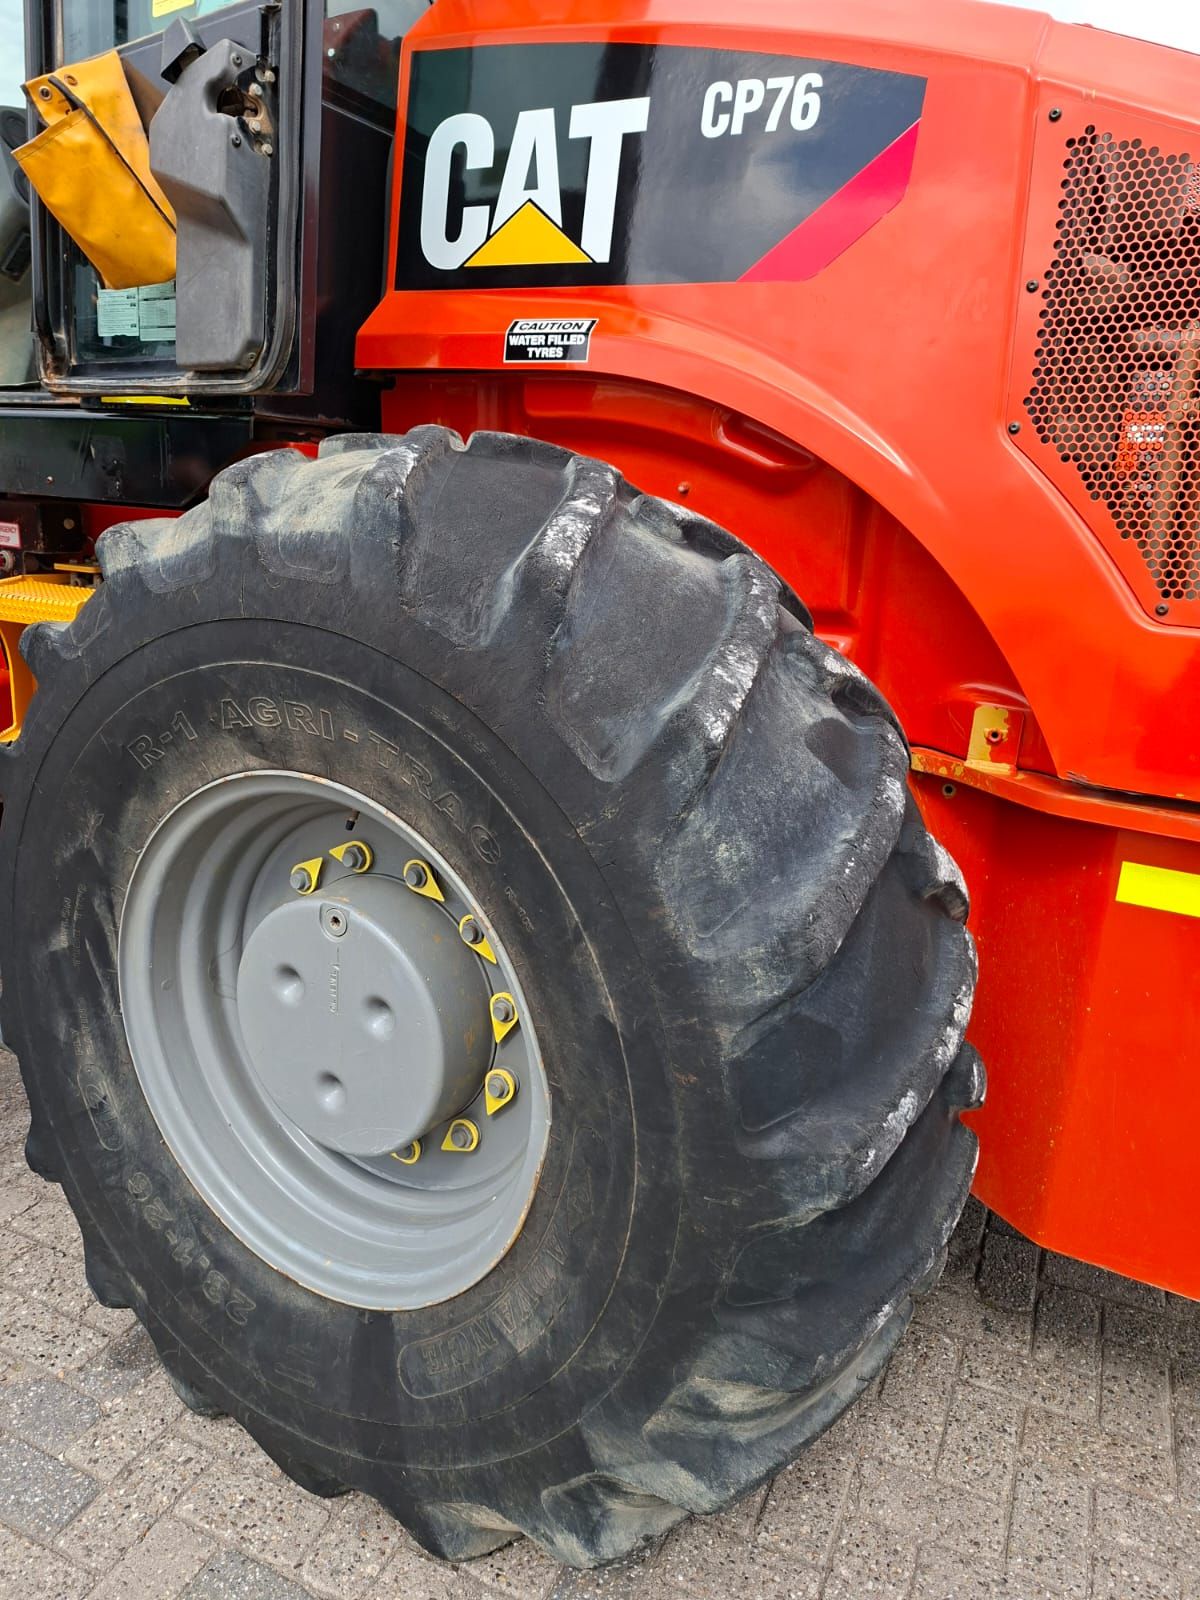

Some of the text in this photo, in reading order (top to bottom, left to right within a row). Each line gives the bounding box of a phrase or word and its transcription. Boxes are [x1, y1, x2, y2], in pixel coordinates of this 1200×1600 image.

[700, 72, 823, 138] CP76
[420, 96, 651, 270] CAT
[508, 333, 586, 346] WATER FILLED
[519, 322, 585, 331] CAUTION
[526, 346, 564, 358] TYRES
[126, 710, 199, 770] R-1
